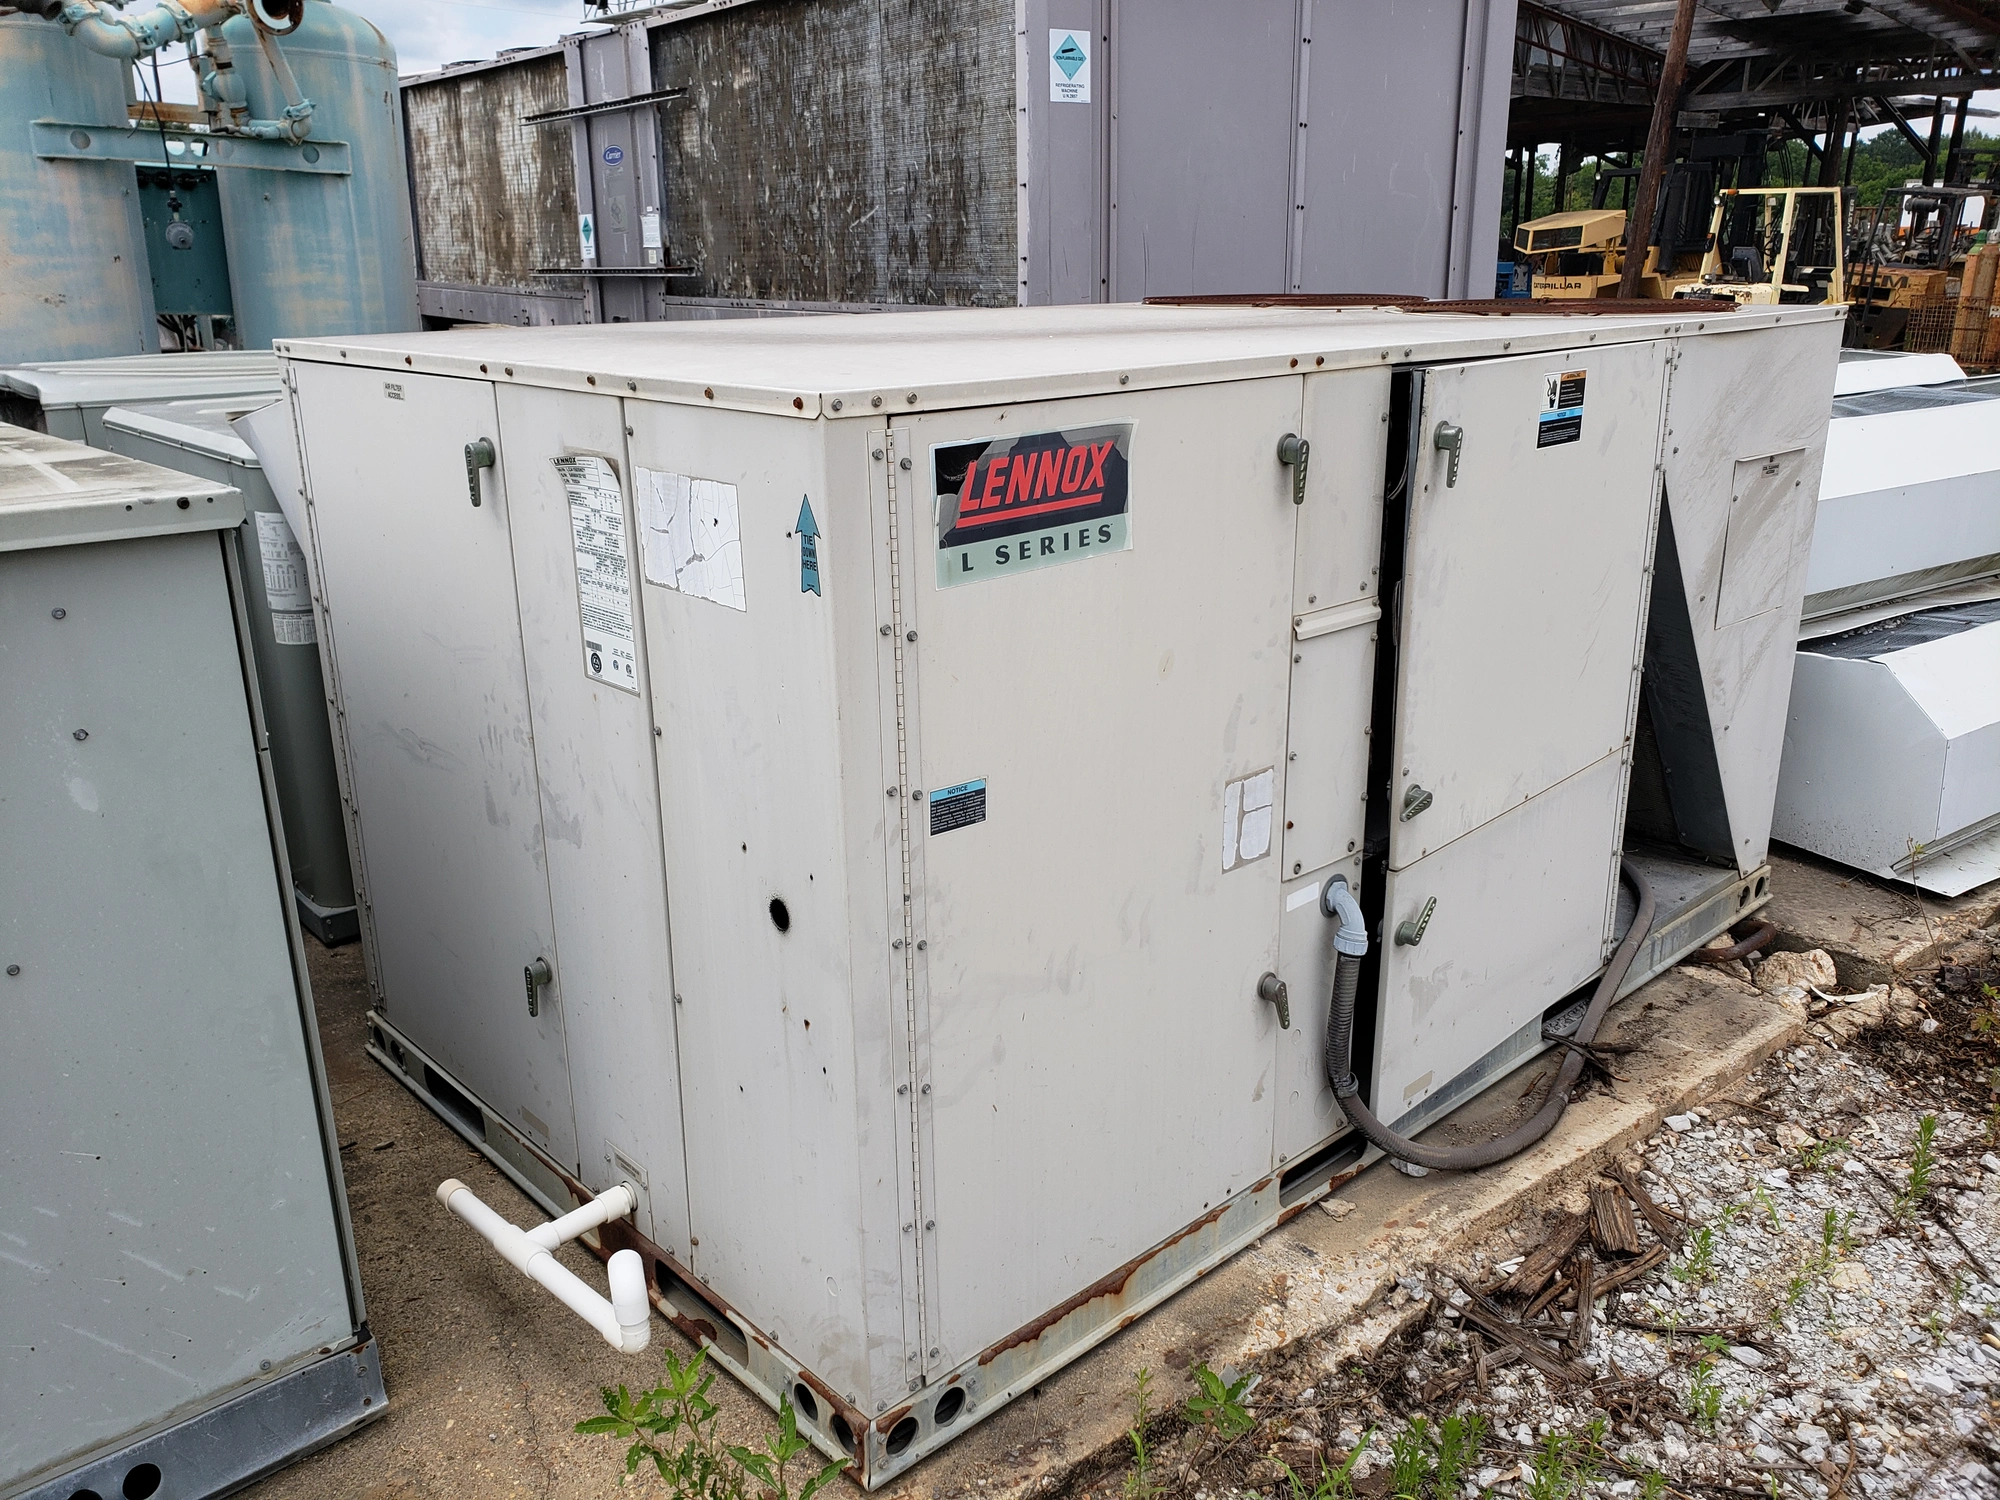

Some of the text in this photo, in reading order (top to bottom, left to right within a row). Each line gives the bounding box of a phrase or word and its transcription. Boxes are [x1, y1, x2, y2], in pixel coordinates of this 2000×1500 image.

[605, 151, 621, 160] Carrier
[1533, 282, 1582, 290] CATERPILLAR
[553, 457, 577, 465] LENNOX
[960, 441, 1114, 512] LENNOX
[803, 534, 814, 546] TIE
[803, 547, 816, 559] DOWN
[961, 524, 1111, 572] L SERIES
[803, 560, 817, 572] HERE
[947, 785, 969, 795] NOTICE
